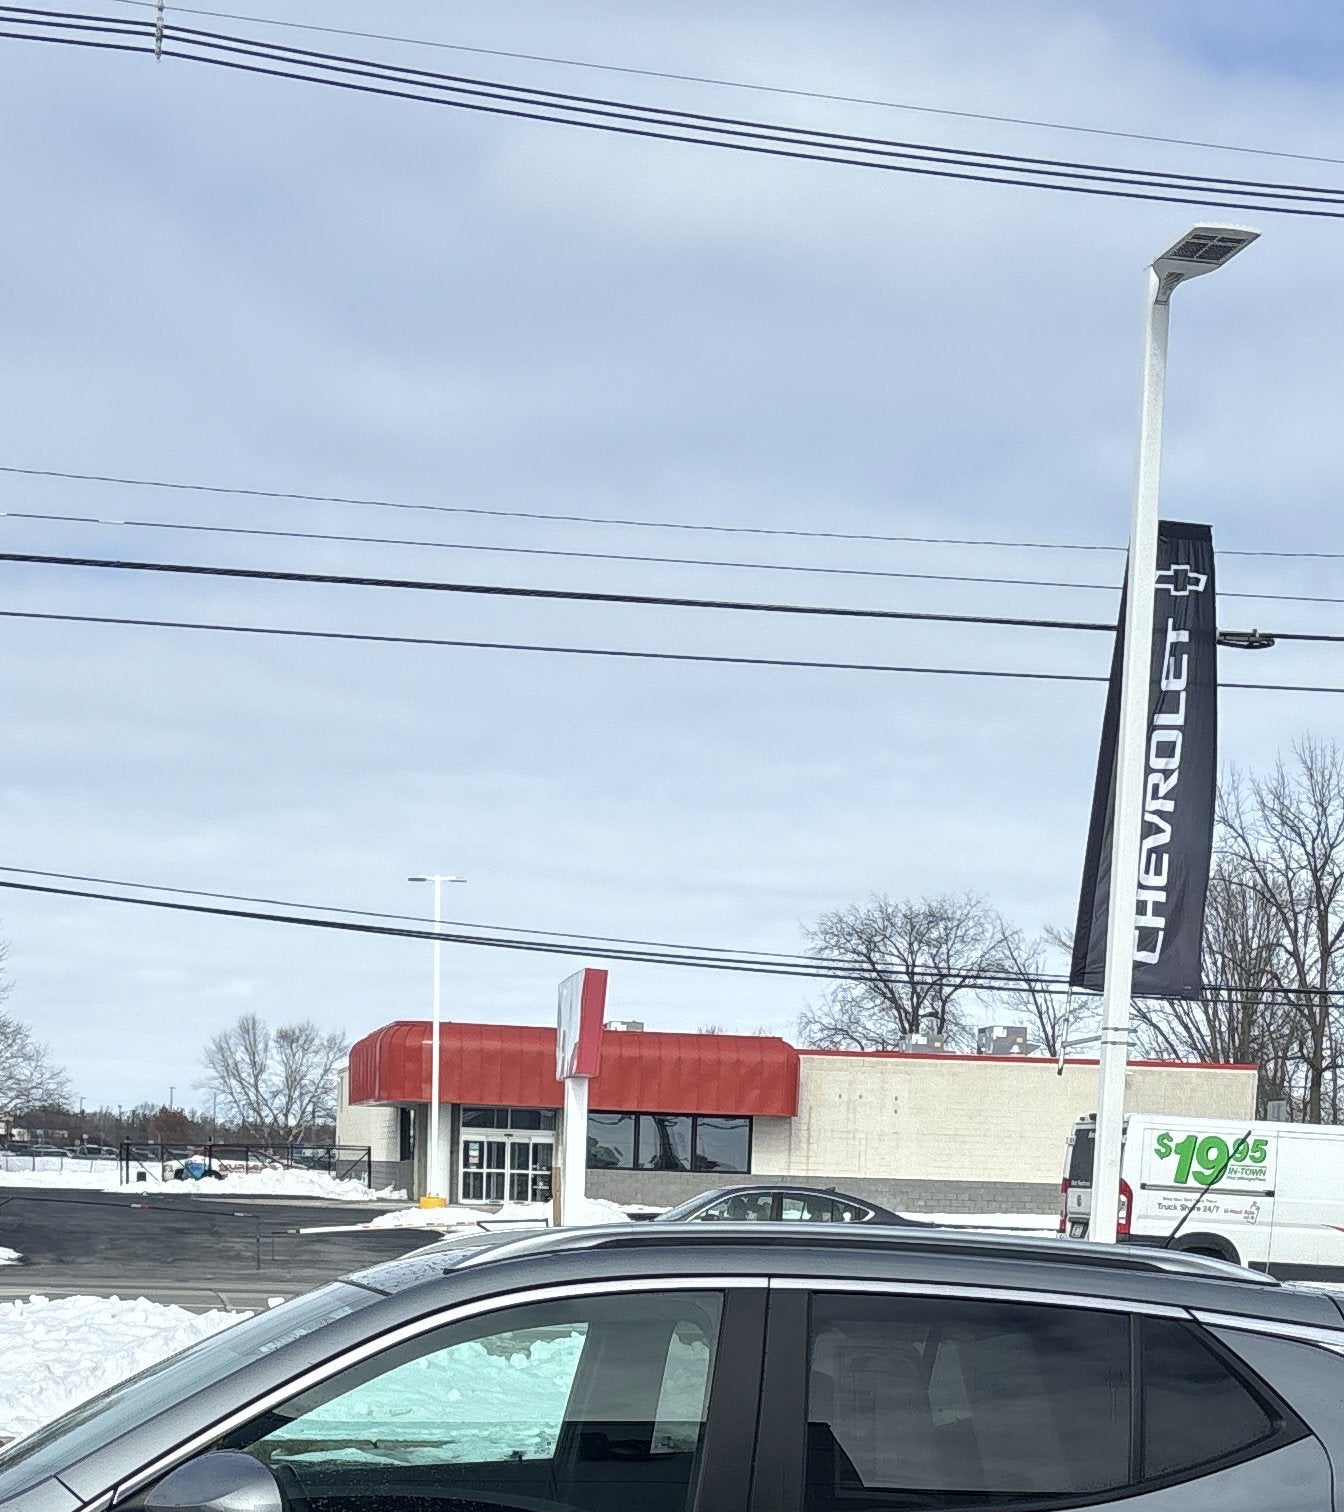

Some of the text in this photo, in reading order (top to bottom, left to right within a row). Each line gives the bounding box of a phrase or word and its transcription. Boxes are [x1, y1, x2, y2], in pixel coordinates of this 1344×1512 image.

[1132, 617, 1190, 965] CHEVROLET
[1227, 1166, 1267, 1177] IN-TOWN
[1203, 1204, 1220, 1214] 24/7
